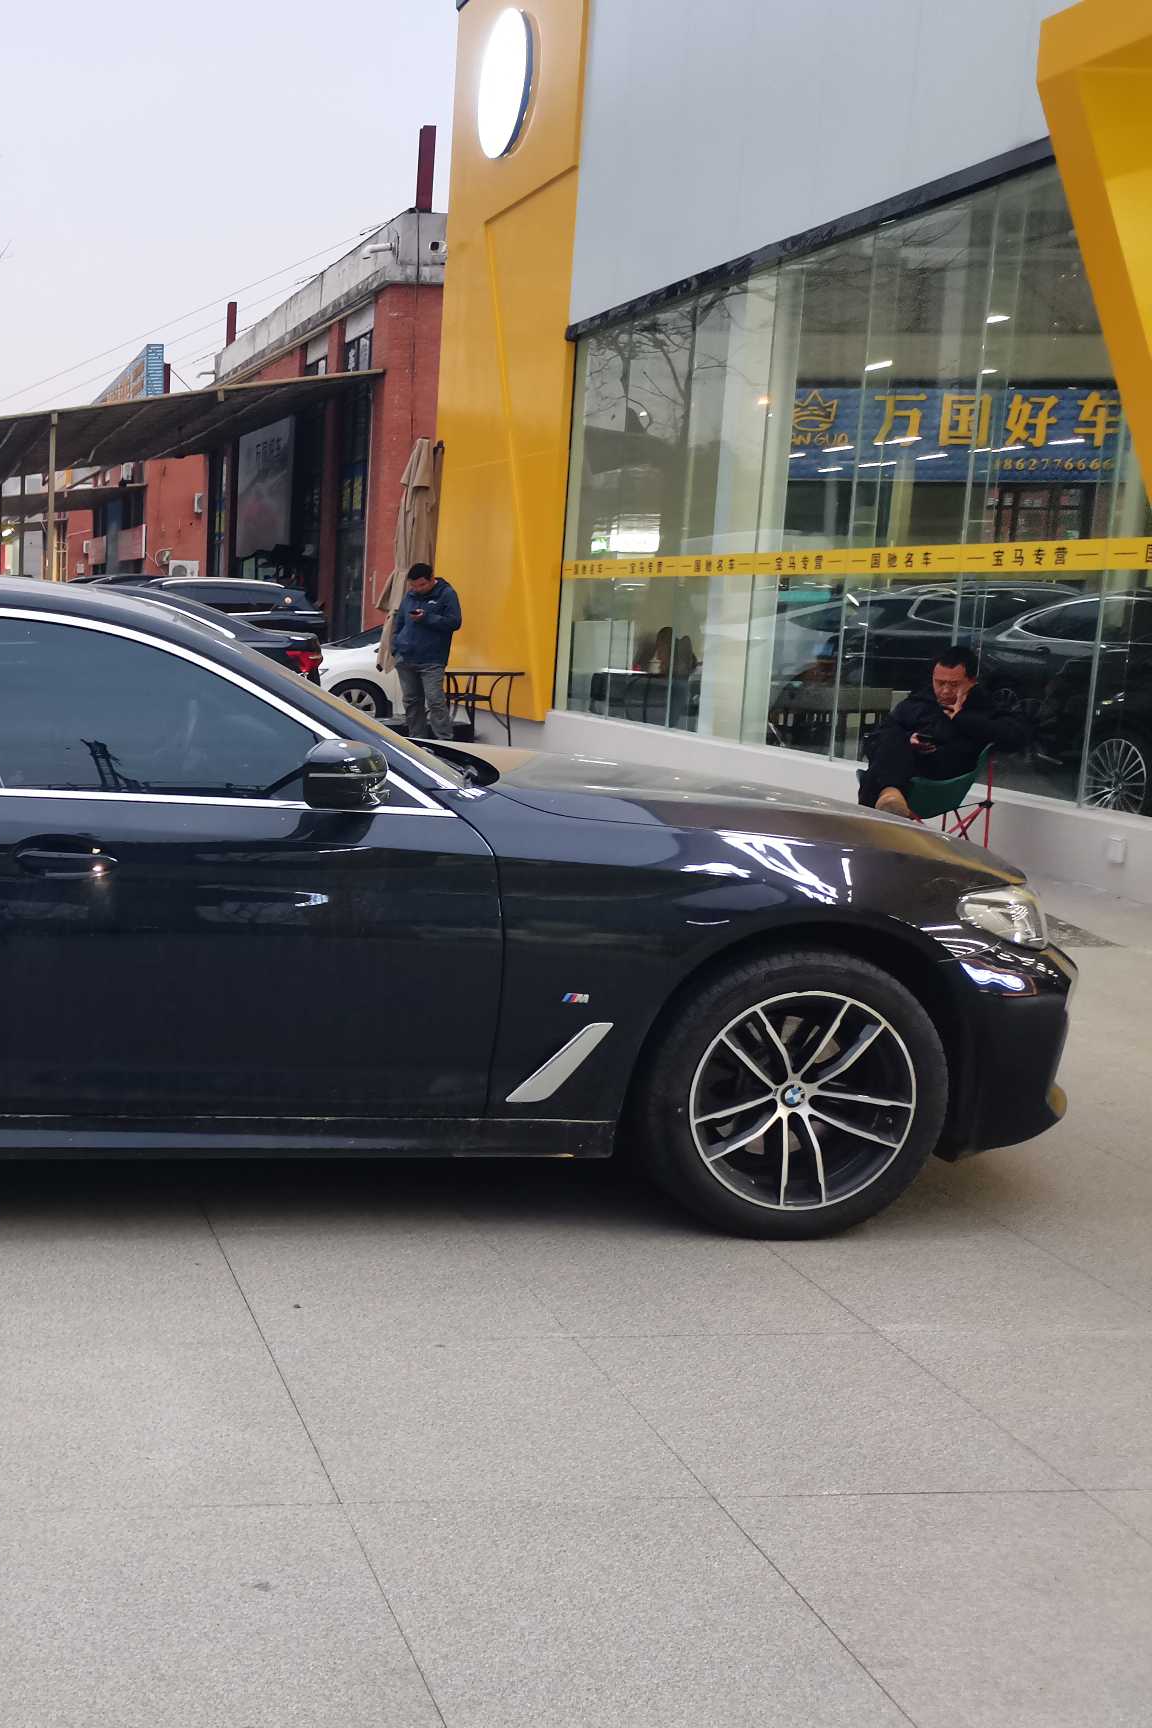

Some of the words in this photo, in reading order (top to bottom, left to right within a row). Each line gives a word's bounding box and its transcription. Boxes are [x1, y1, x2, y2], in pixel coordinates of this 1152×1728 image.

[873, 391, 1121, 447] 万国好车
[992, 546, 1069, 566] 宝马专营
